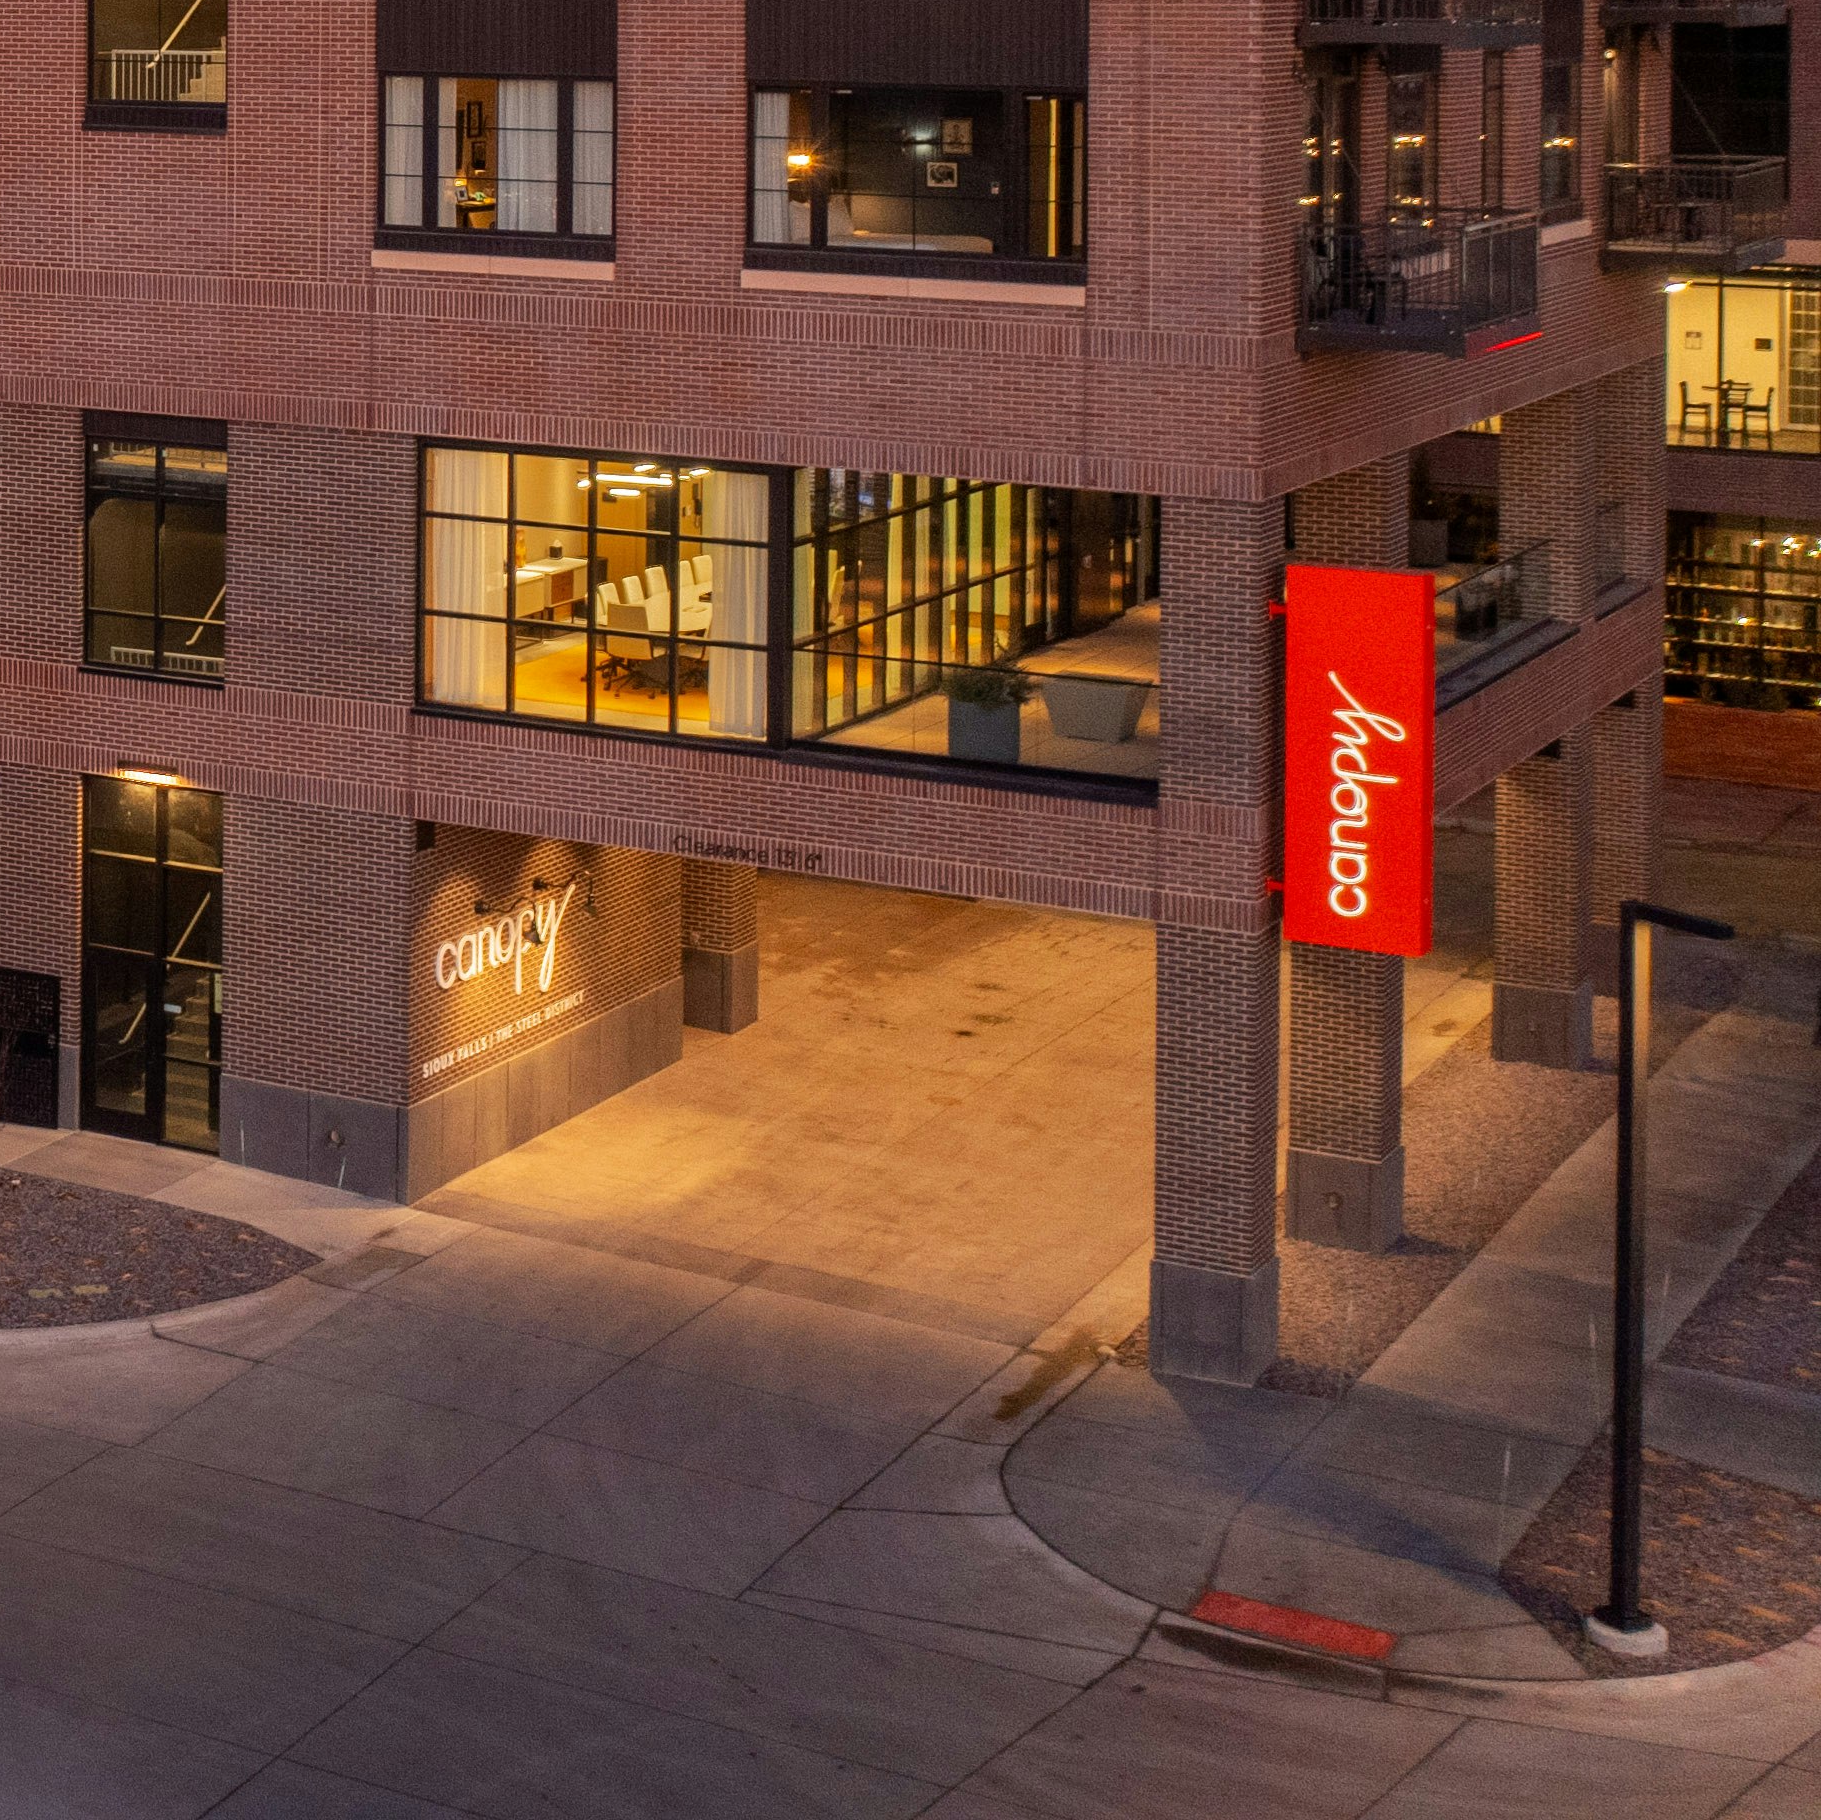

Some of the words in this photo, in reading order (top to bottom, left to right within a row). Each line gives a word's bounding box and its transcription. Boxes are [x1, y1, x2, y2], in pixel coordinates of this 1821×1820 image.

[1329, 671, 1405, 917] canopy
[674, 835, 769, 863] Clearance
[436, 884, 576, 995] canopy
[422, 1053, 454, 1079] SIOUX
[456, 1035, 487, 1060] FALLS
[495, 1024, 514, 1043] THE
[516, 1013, 542, 1033] STEEL
[545, 990, 585, 1020] DISTRICT
